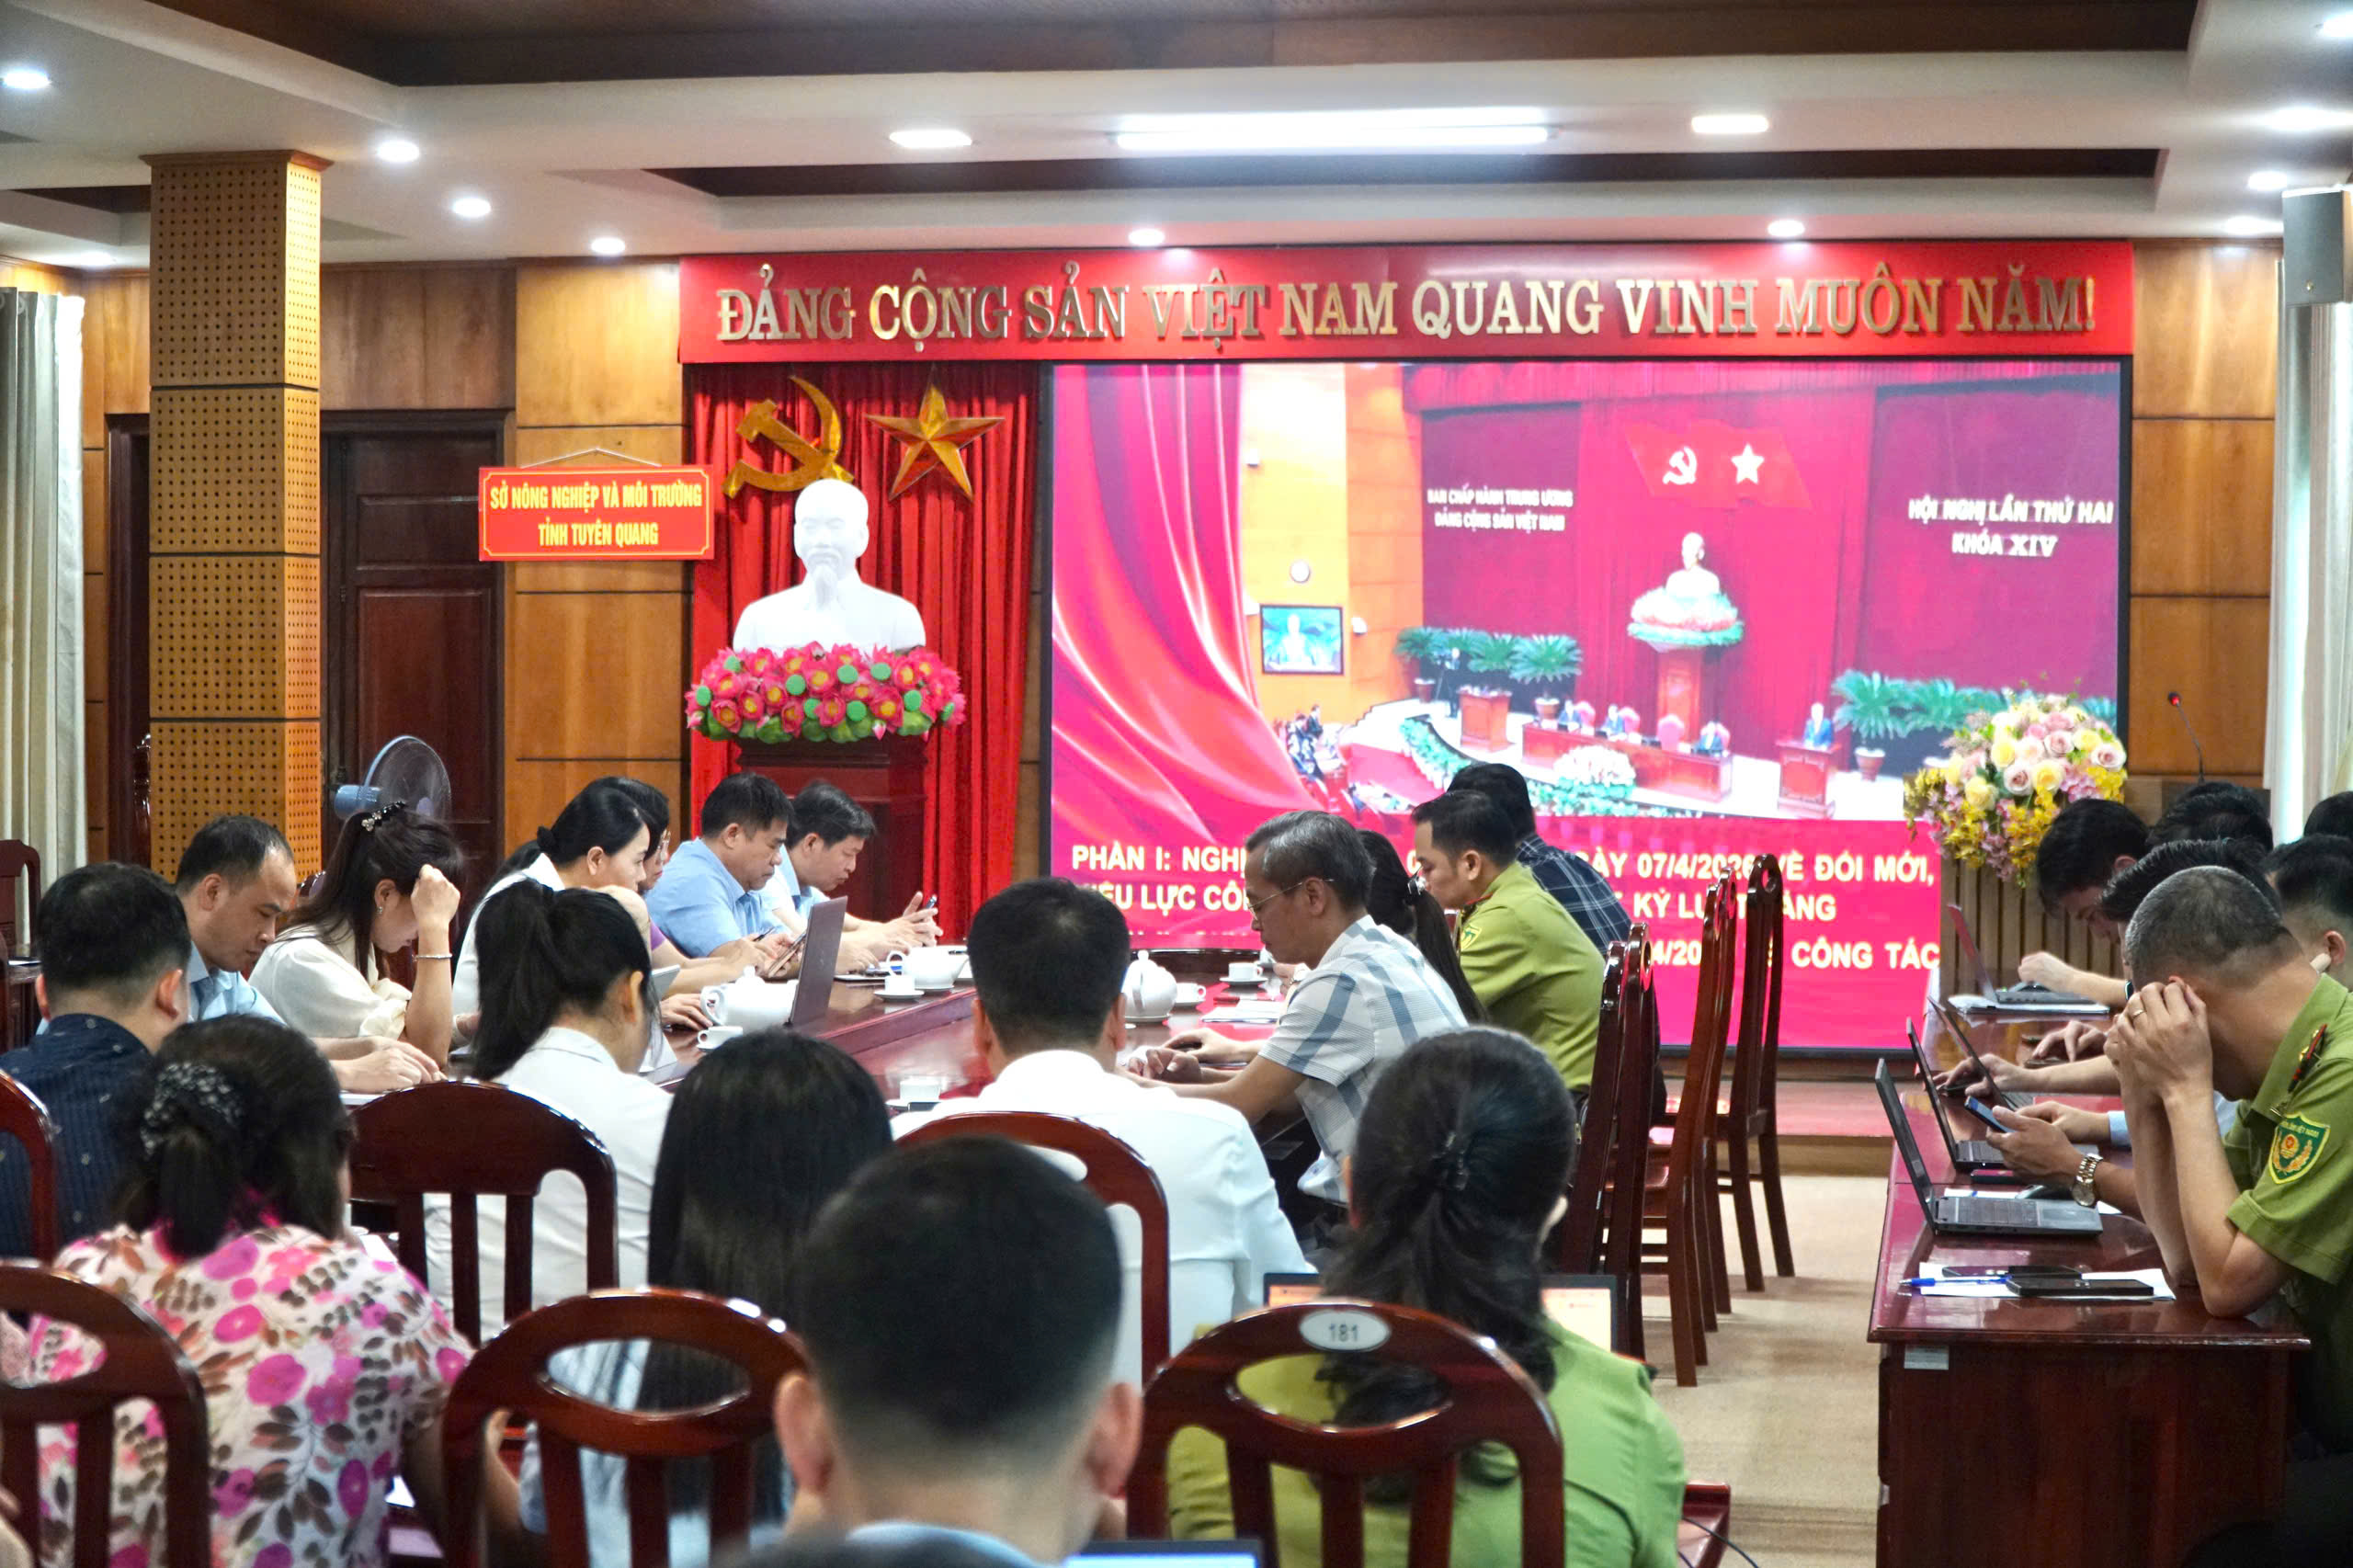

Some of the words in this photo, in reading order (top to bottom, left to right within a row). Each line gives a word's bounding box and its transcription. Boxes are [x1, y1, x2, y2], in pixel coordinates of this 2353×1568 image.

[716, 263, 857, 340] ĐẢNG
[870, 267, 1012, 353] CỘNG
[1025, 261, 1129, 337] SẢN
[1142, 268, 1265, 349] VIỆT
[1279, 281, 1398, 335] NAM
[1412, 279, 1605, 336] QUANG
[1616, 278, 1757, 335] VINH
[1776, 261, 1943, 335] MUÔN
[1957, 264, 2096, 333] NĂM!
[490, 479, 509, 509] SỞ
[511, 482, 549, 508] NÔNG
[551, 481, 599, 513] NGHIỆP
[602, 481, 620, 508] VÀ
[622, 480, 648, 507] MÔI
[651, 479, 702, 506] TRƯỜNG
[1908, 494, 1938, 524] HỘI
[2078, 501, 2114, 524] HAI
[538, 516, 569, 546] TỈNH
[571, 518, 612, 546] TUYÊN
[615, 522, 659, 548] QUANG
[1951, 528, 2004, 555] KHÓA
[2008, 534, 2058, 558] XIV
[1155, 846, 1171, 871] I:
[1141, 883, 1196, 917] LỰC
[1791, 936, 1873, 969] CÔNG
[1884, 937, 1940, 970] TÁC
[1329, 1324, 1358, 1342] 181
